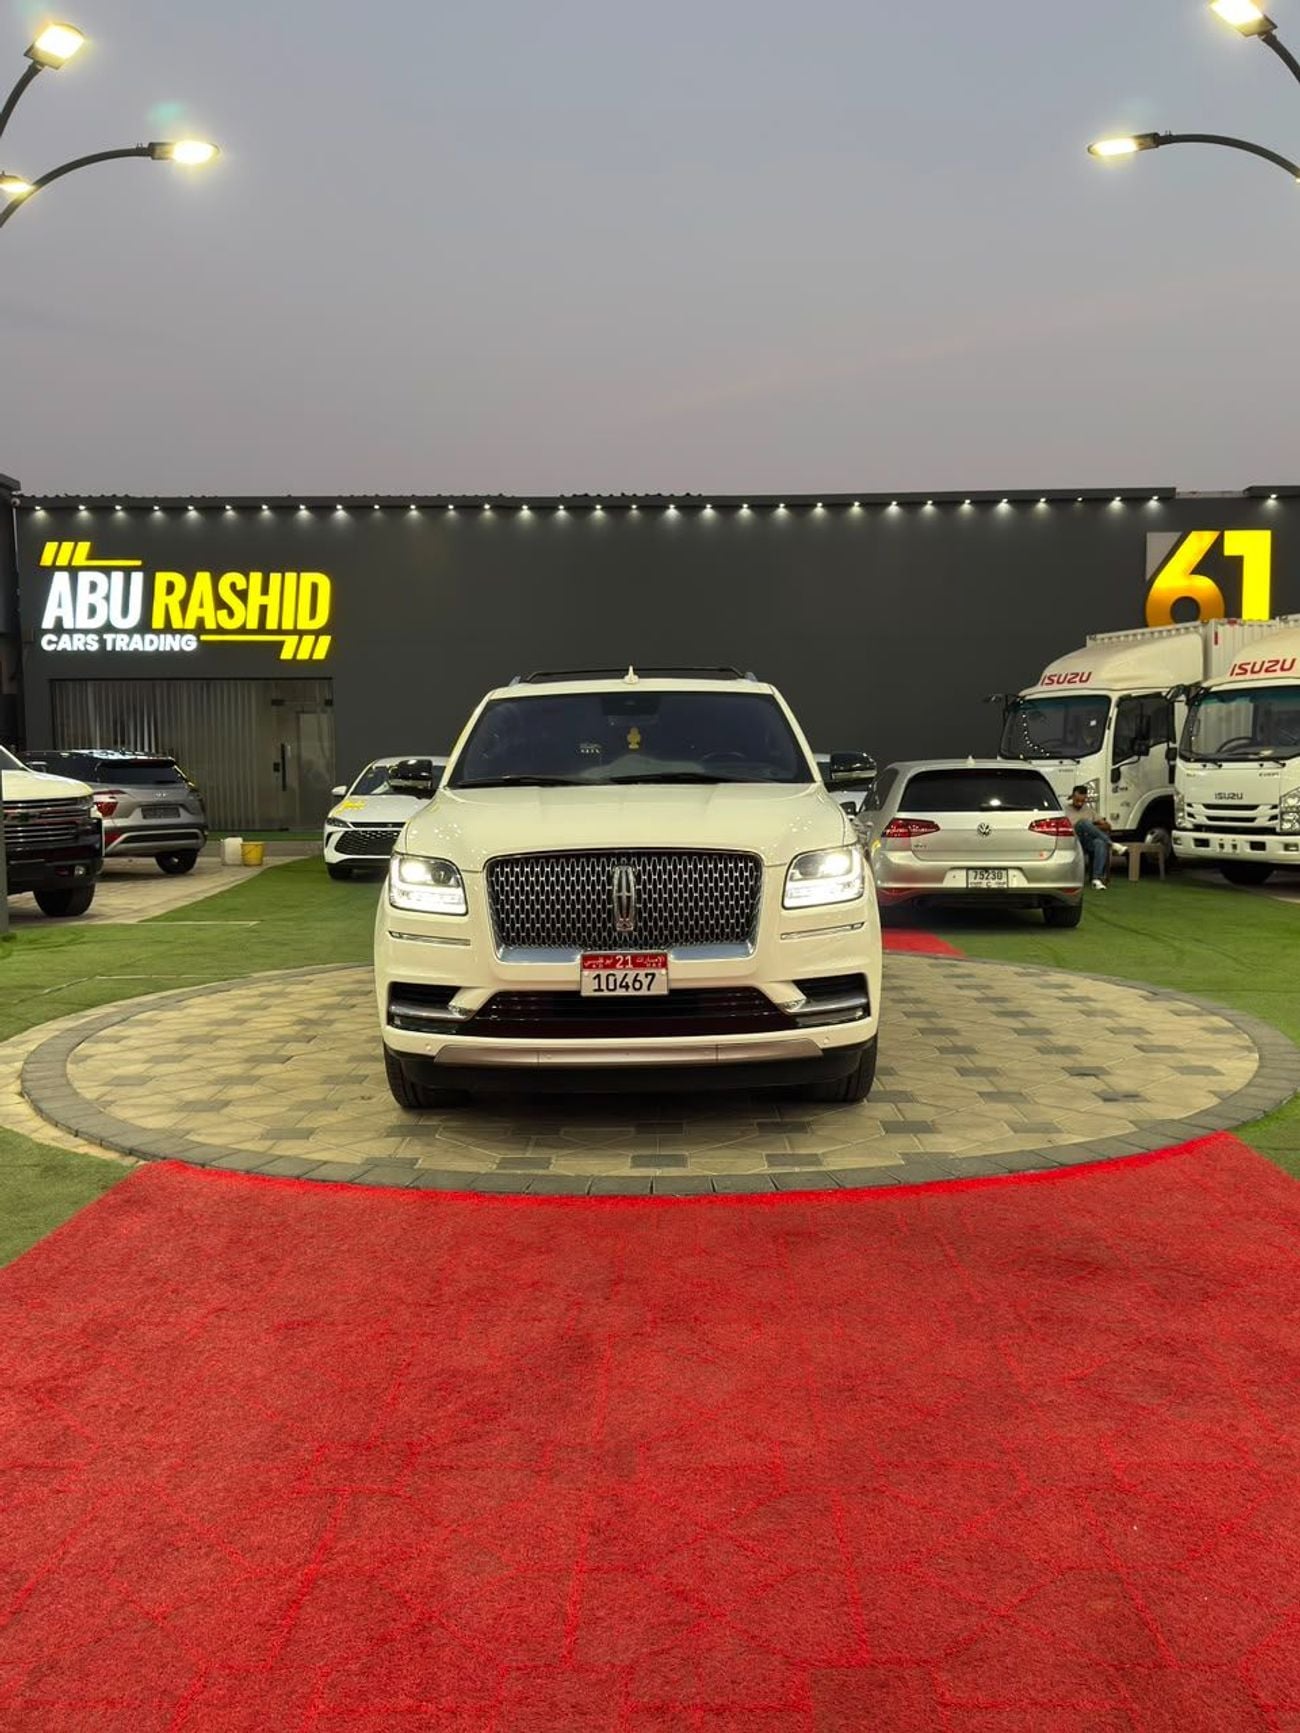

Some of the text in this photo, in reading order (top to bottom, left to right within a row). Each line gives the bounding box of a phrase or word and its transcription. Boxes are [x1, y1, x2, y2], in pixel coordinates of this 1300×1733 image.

[1145, 529, 1272, 629] 61
[41, 571, 332, 630] ABU RASHID
[40, 633, 199, 652] CARS TRADING
[1229, 657, 1296, 677] ISUZU
[1040, 671, 1092, 686] ISUZU
[1214, 792, 1243, 801] ISUZU
[615, 955, 634, 969] 21
[592, 972, 657, 992] 10467
